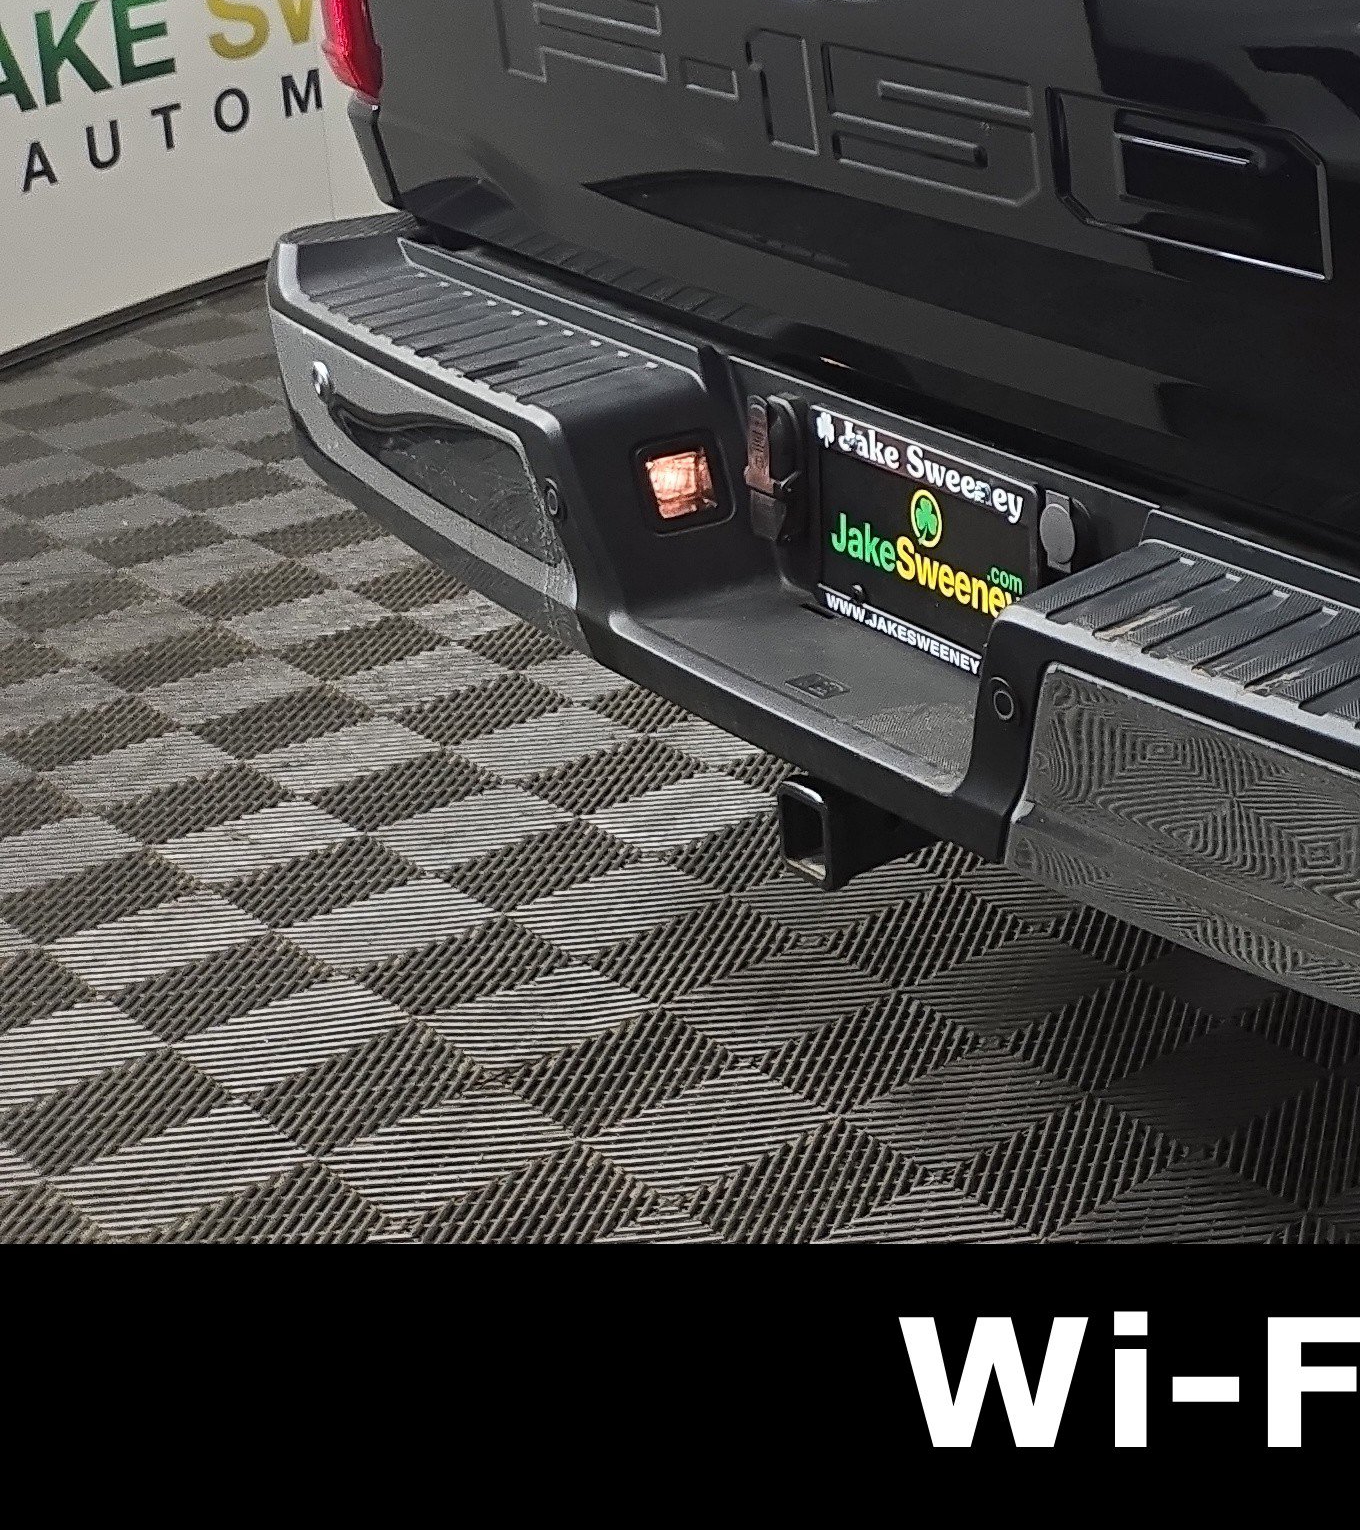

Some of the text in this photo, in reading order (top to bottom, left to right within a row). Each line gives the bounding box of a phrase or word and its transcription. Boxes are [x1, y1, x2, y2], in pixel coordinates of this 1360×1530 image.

[22, 69, 323, 194] AUTOM
[838, 421, 900, 470] Jake
[906, 445, 1024, 524] Sweeney
